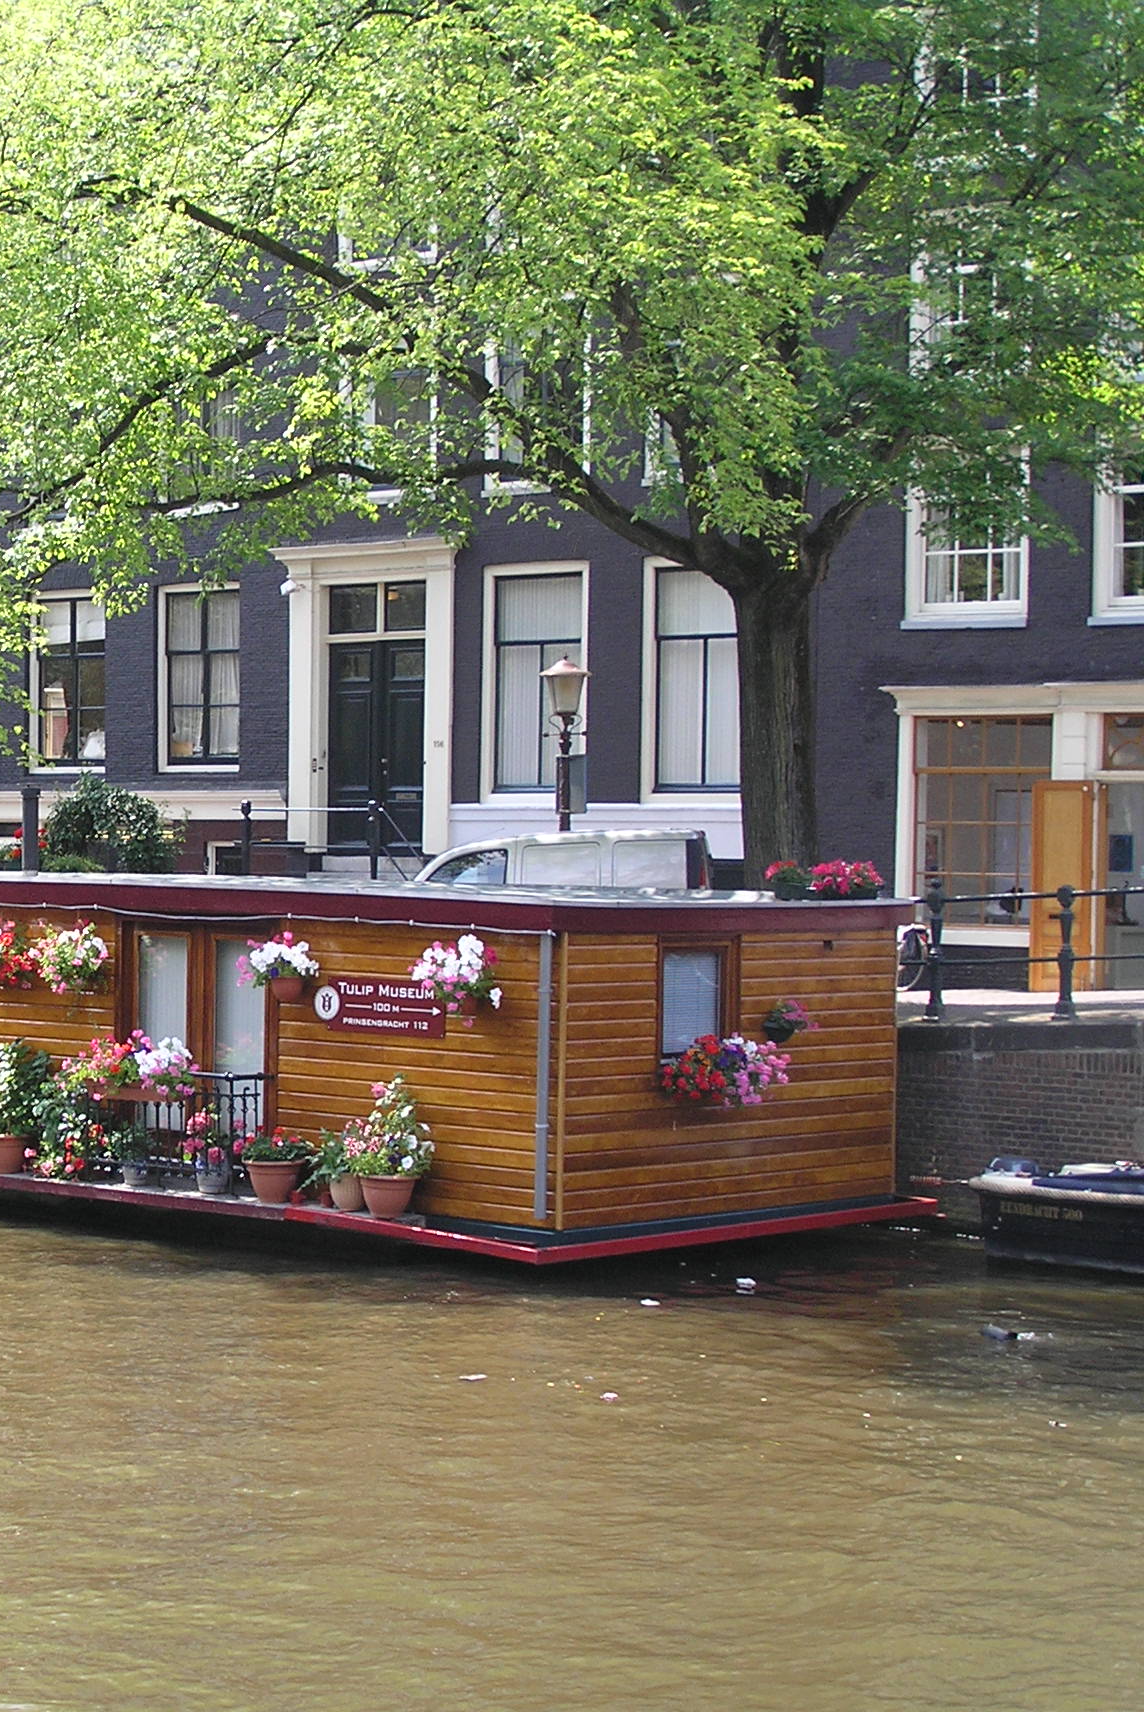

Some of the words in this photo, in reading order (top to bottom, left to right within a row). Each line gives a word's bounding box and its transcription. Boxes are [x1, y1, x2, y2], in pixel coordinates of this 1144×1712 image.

[338, 982, 374, 996] TULIP
[378, 984, 435, 1000] MUSEUM
[372, 1003, 391, 1012] 100
[342, 1017, 410, 1029] PRINSENGRACHT
[413, 1021, 429, 1030] 112
